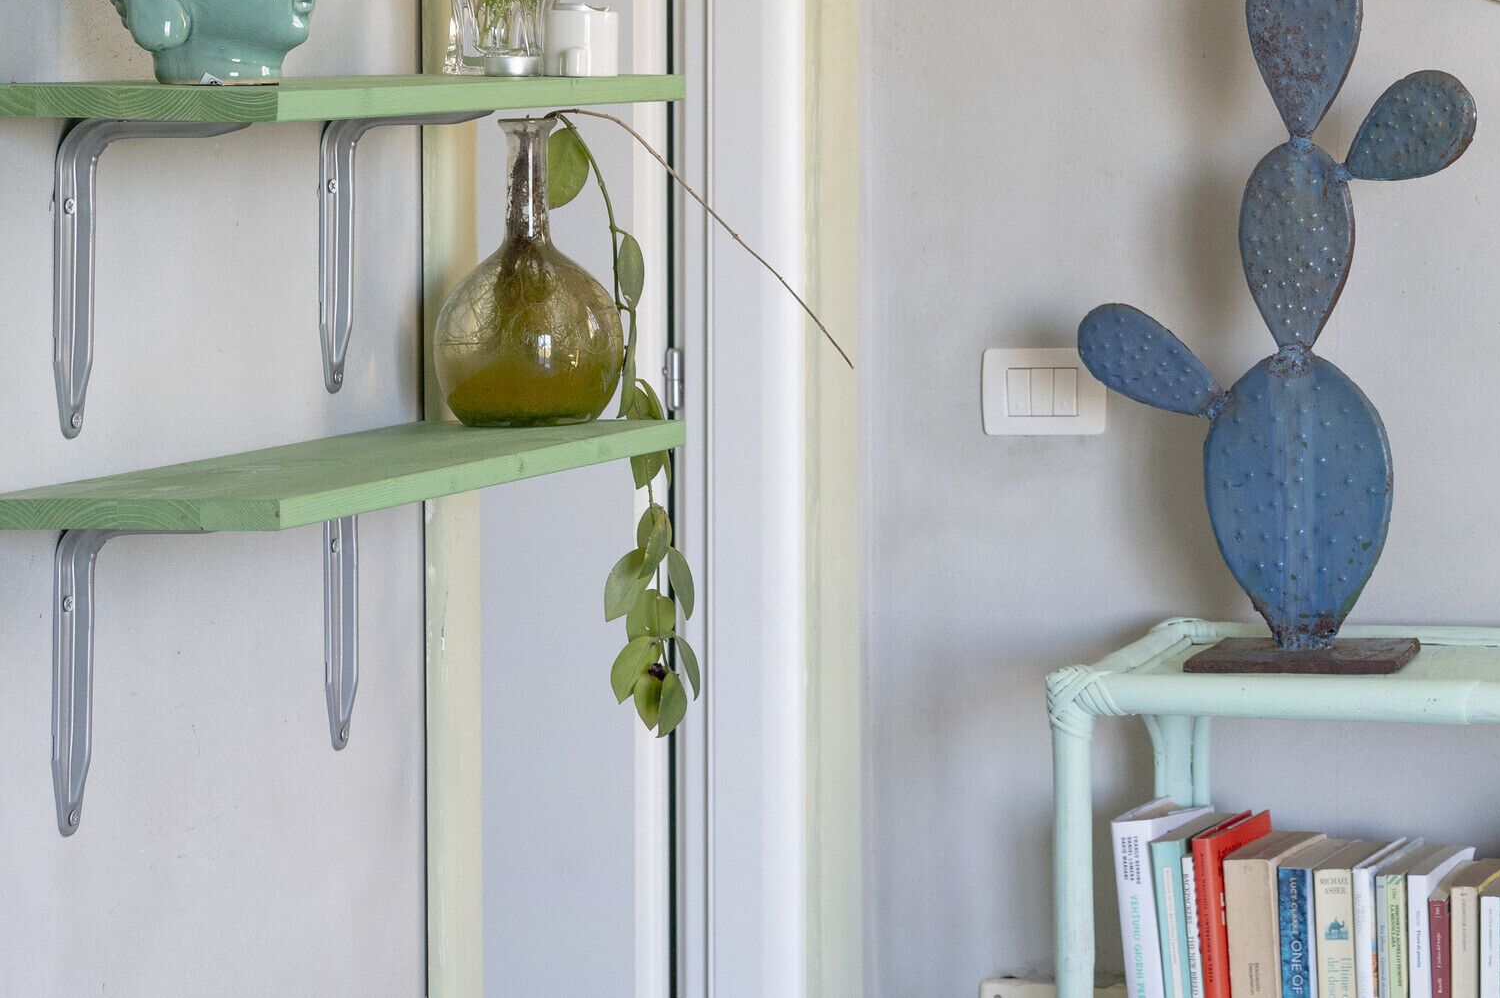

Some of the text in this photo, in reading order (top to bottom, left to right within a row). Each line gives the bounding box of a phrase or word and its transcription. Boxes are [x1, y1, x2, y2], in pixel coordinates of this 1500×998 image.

[1319, 877, 1349, 885] MICHAEL
[1131, 895, 1141, 940] VENTUNO
[1289, 877, 1304, 995] LUCY CLARKE ONE OF
[1134, 943, 1144, 979] GIORNI
